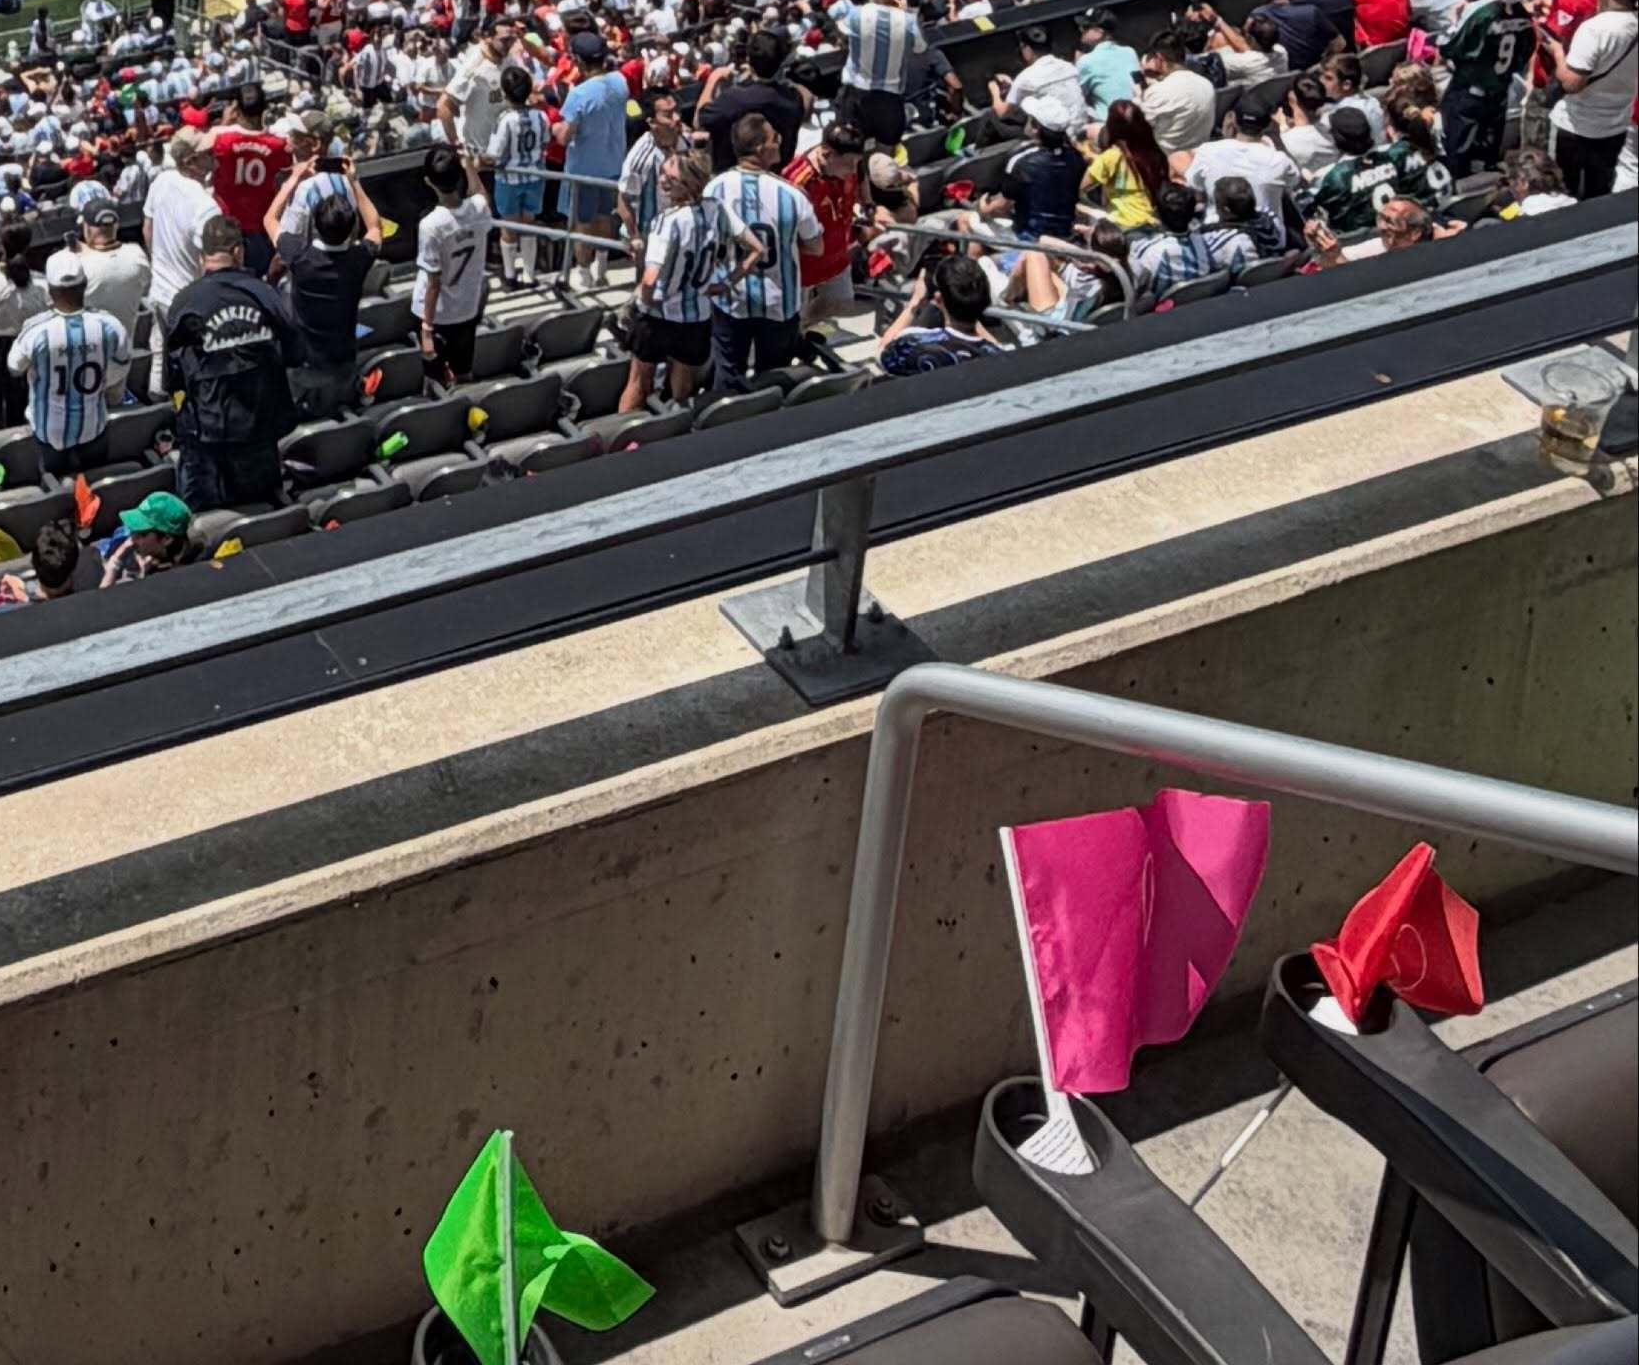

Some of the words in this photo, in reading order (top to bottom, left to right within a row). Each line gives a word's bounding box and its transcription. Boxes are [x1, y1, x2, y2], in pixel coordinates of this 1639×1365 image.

[1494, 33, 1516, 75] 9
[234, 156, 267, 187] 10
[448, 244, 476, 288] 7
[205, 304, 262, 332] YANKEES
[53, 360, 103, 396] 10
